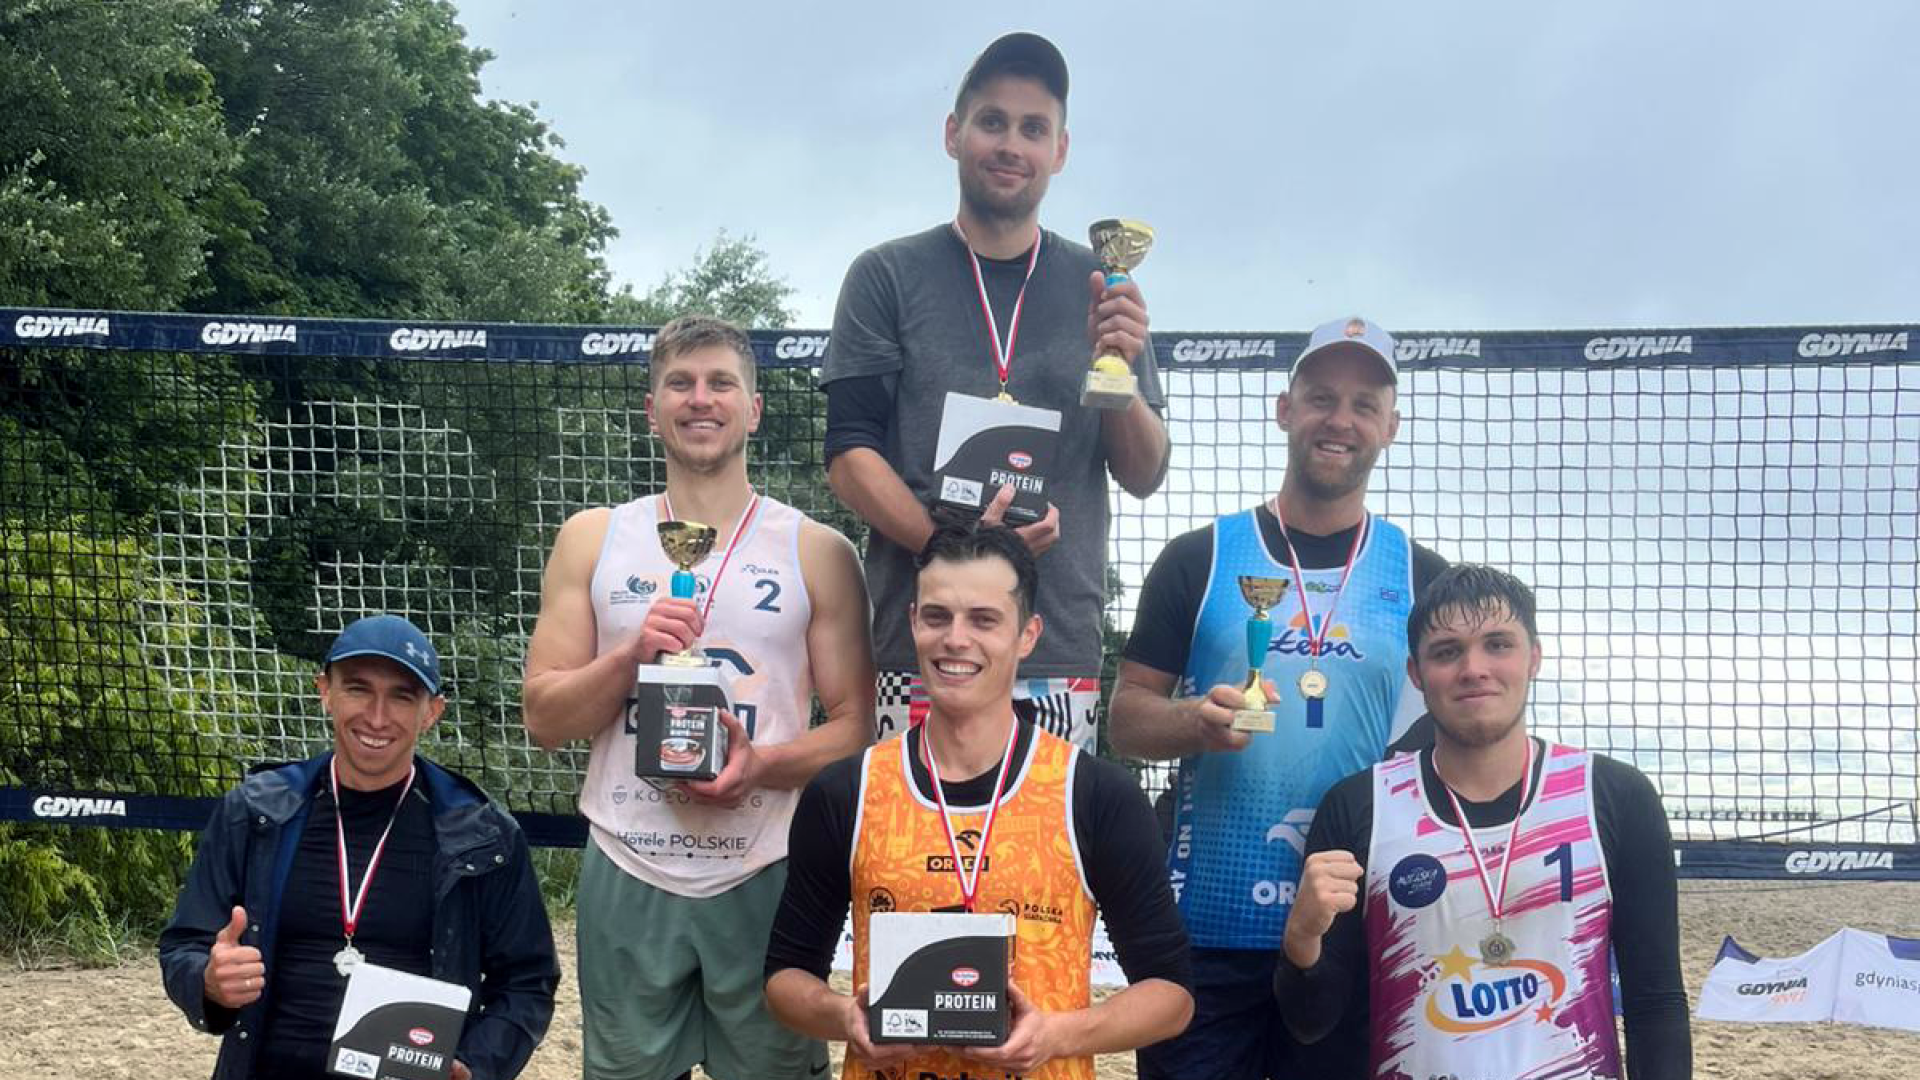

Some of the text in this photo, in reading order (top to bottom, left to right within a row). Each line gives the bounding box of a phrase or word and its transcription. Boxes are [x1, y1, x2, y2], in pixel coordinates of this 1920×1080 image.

[15, 315, 110, 337] GDYNIA
[202, 322, 297, 345] GDYNIA
[389, 327, 487, 351] GDYNIA
[581, 333, 658, 355] GDYN
[776, 336, 830, 360] GDY
[1172, 339, 1276, 362] GDYNIA
[1394, 338, 1481, 361] DYNIA
[1584, 335, 1692, 361] GDYNIA
[1797, 332, 1908, 358] GDYNIA
[990, 471, 1044, 494] PROTEIN
[754, 579, 781, 613] 2
[33, 796, 126, 817] GDYNIA
[669, 834, 748, 851] POLSKIE
[1177, 824, 1192, 859] ON
[1543, 842, 1574, 902] 1
[1785, 851, 1894, 873] GDYNIA
[1024, 903, 1064, 916] POLSKA
[1451, 973, 1539, 1019] LOTTO
[1737, 977, 1808, 996] GDYNIA
[935, 994, 997, 1010] PROTEIN
[387, 1045, 444, 1071] PROTEIN
